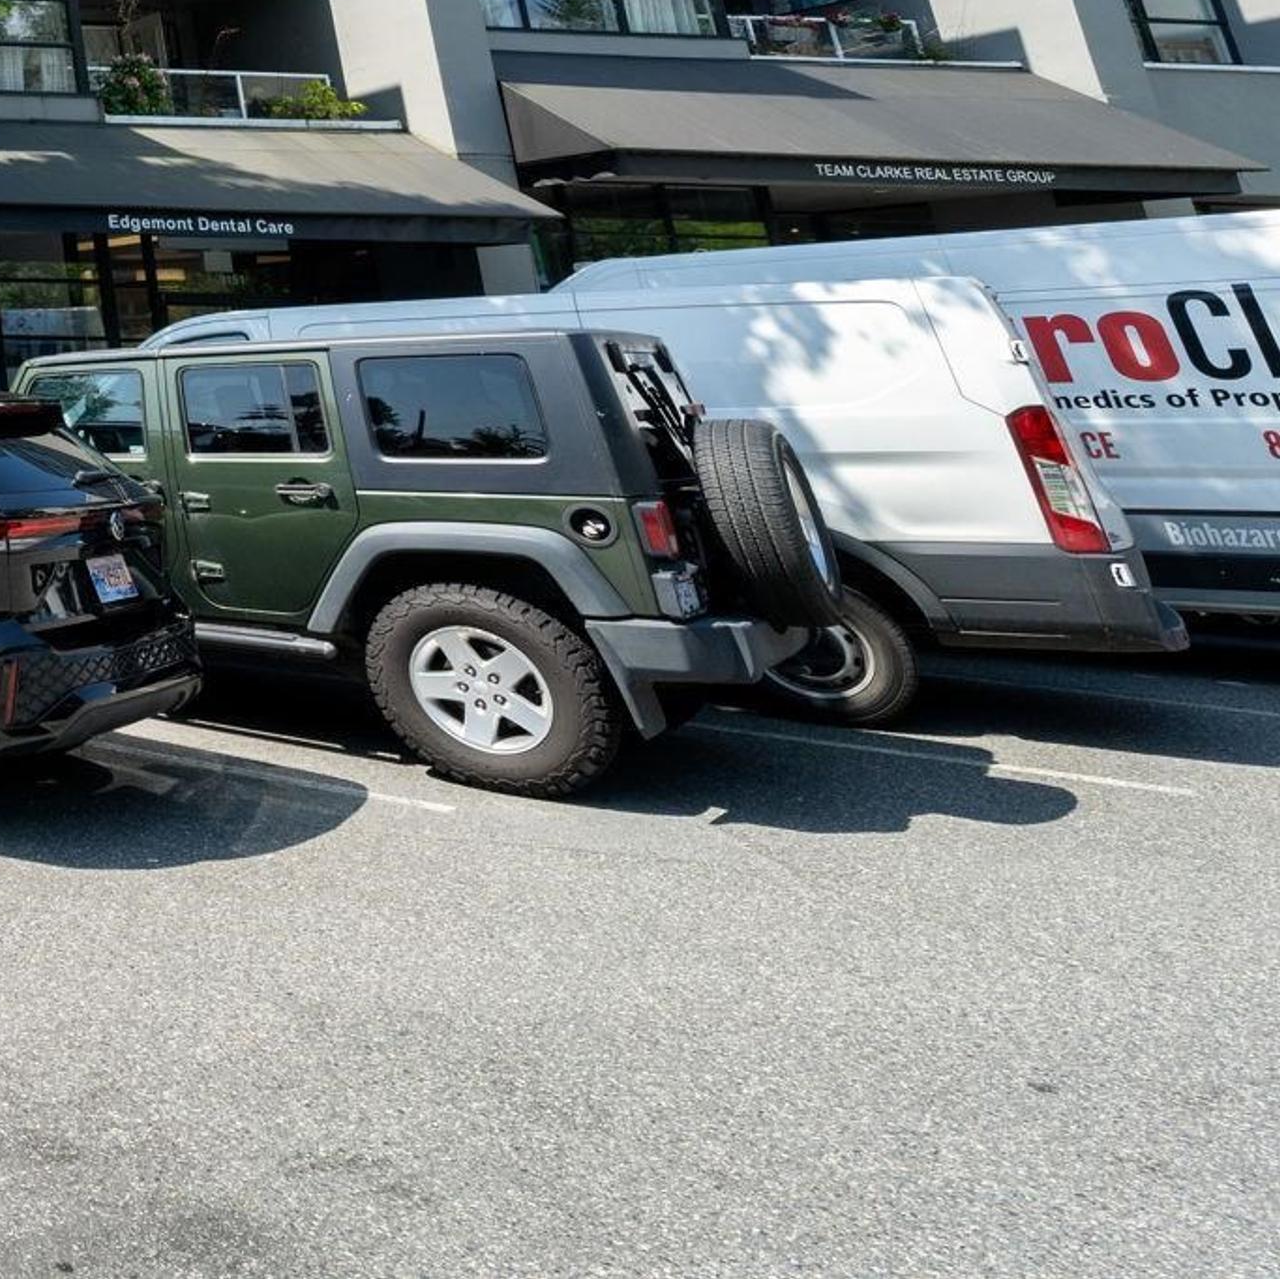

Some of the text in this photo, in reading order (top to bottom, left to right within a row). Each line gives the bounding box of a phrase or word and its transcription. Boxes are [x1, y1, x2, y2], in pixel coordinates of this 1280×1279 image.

[815, 163, 1056, 184] TEAM CLARKE REAL ESTATE GROUP
[107, 214, 295, 235] Edgemont Dental Care
[1166, 388, 1200, 408] of
[1163, 521, 1280, 549] Biohazar
